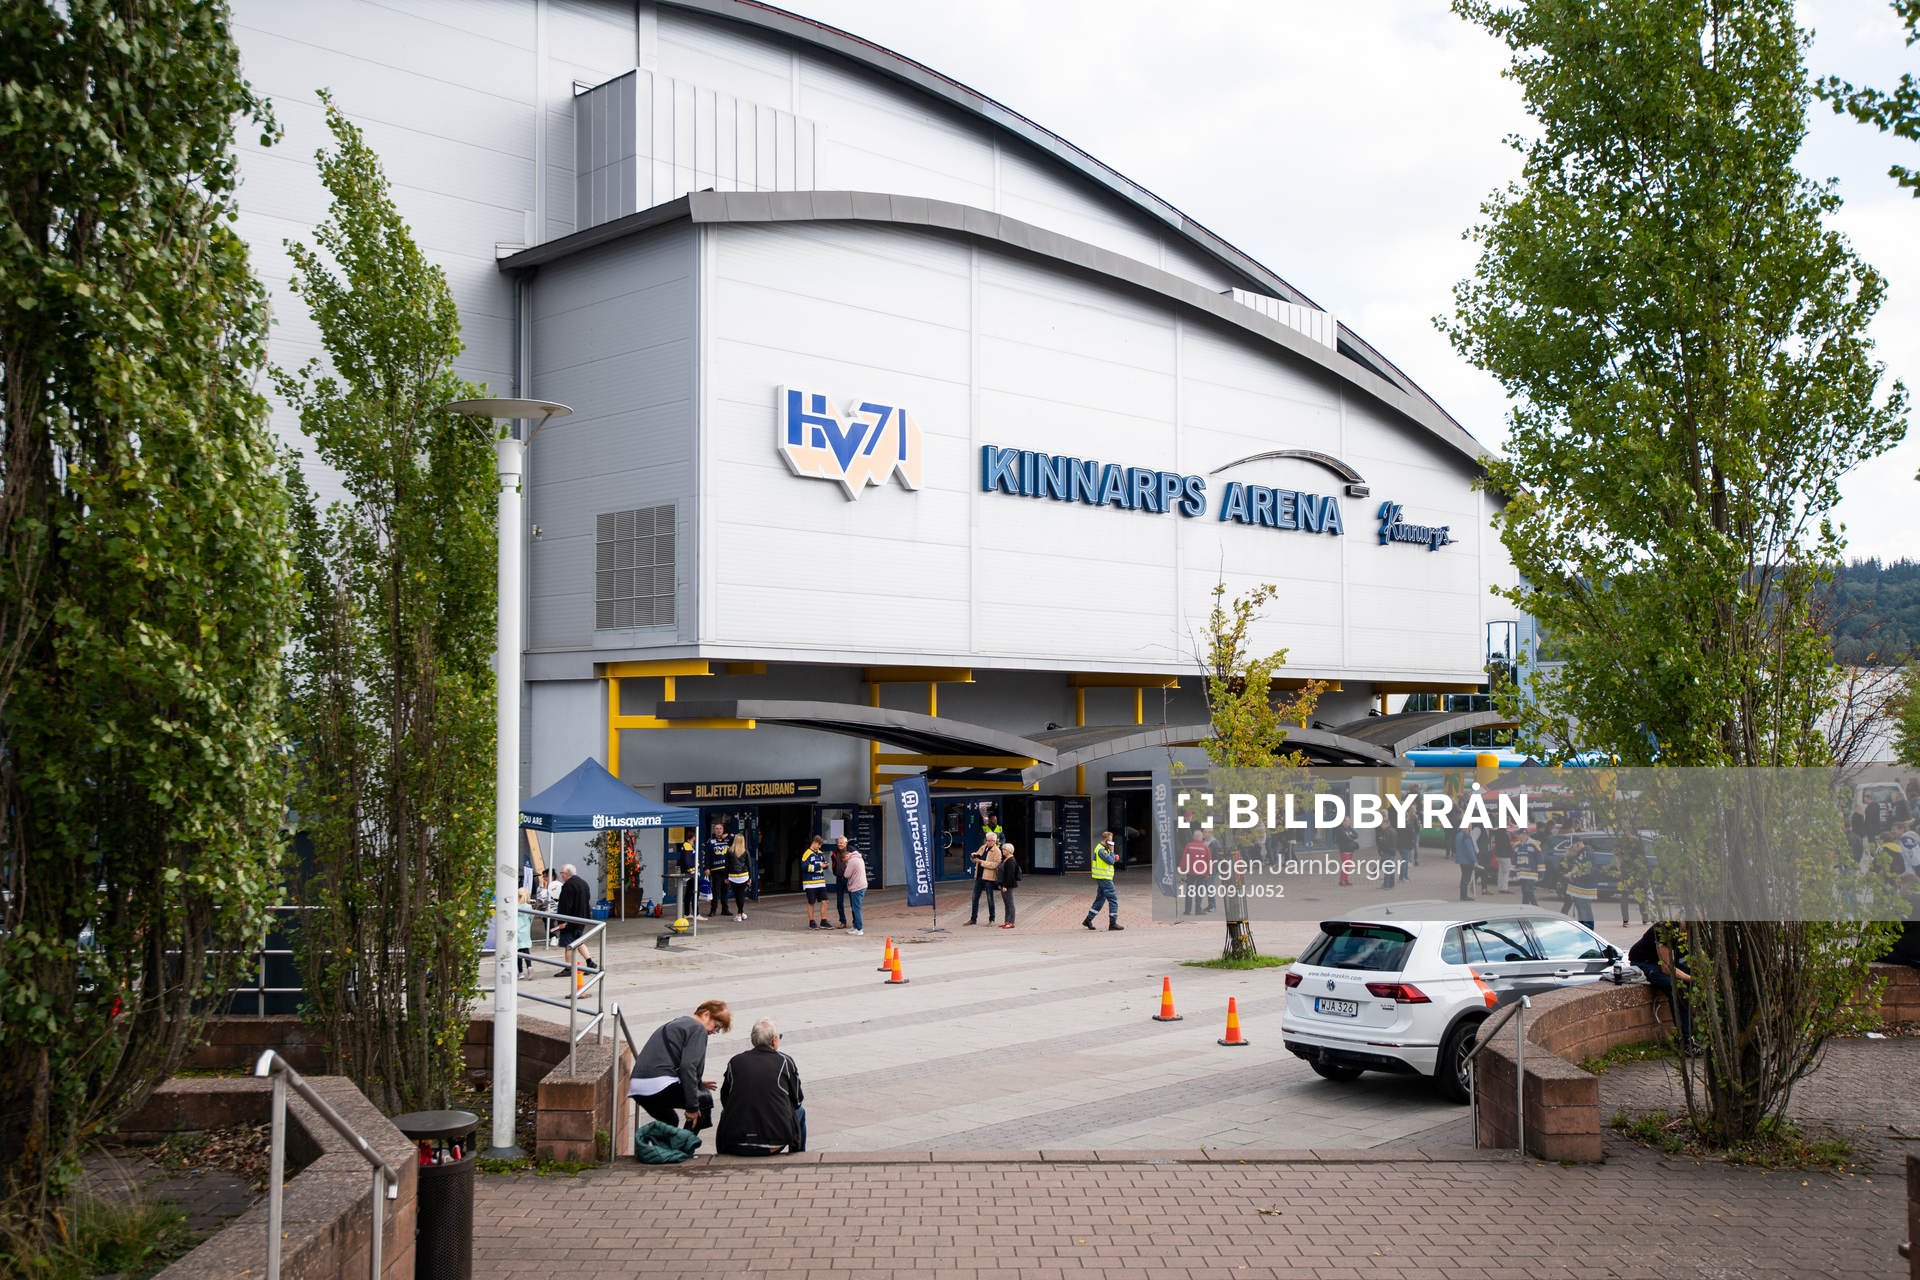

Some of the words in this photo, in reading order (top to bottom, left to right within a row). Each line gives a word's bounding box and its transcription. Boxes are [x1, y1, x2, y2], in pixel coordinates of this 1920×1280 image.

[788, 389, 906, 473] HV71
[982, 445, 1207, 517] KINNARPS
[1219, 481, 1345, 535] ARENA
[1378, 500, 1459, 551] Kinnarps
[695, 783, 738, 798] BILJETTER
[745, 782, 795, 798] RESTAURANG
[532, 816, 543, 825] ARE
[605, 816, 661, 828] Husqvarna
[1321, 1000, 1336, 1012] WJA
[1337, 1002, 1354, 1013] 326
